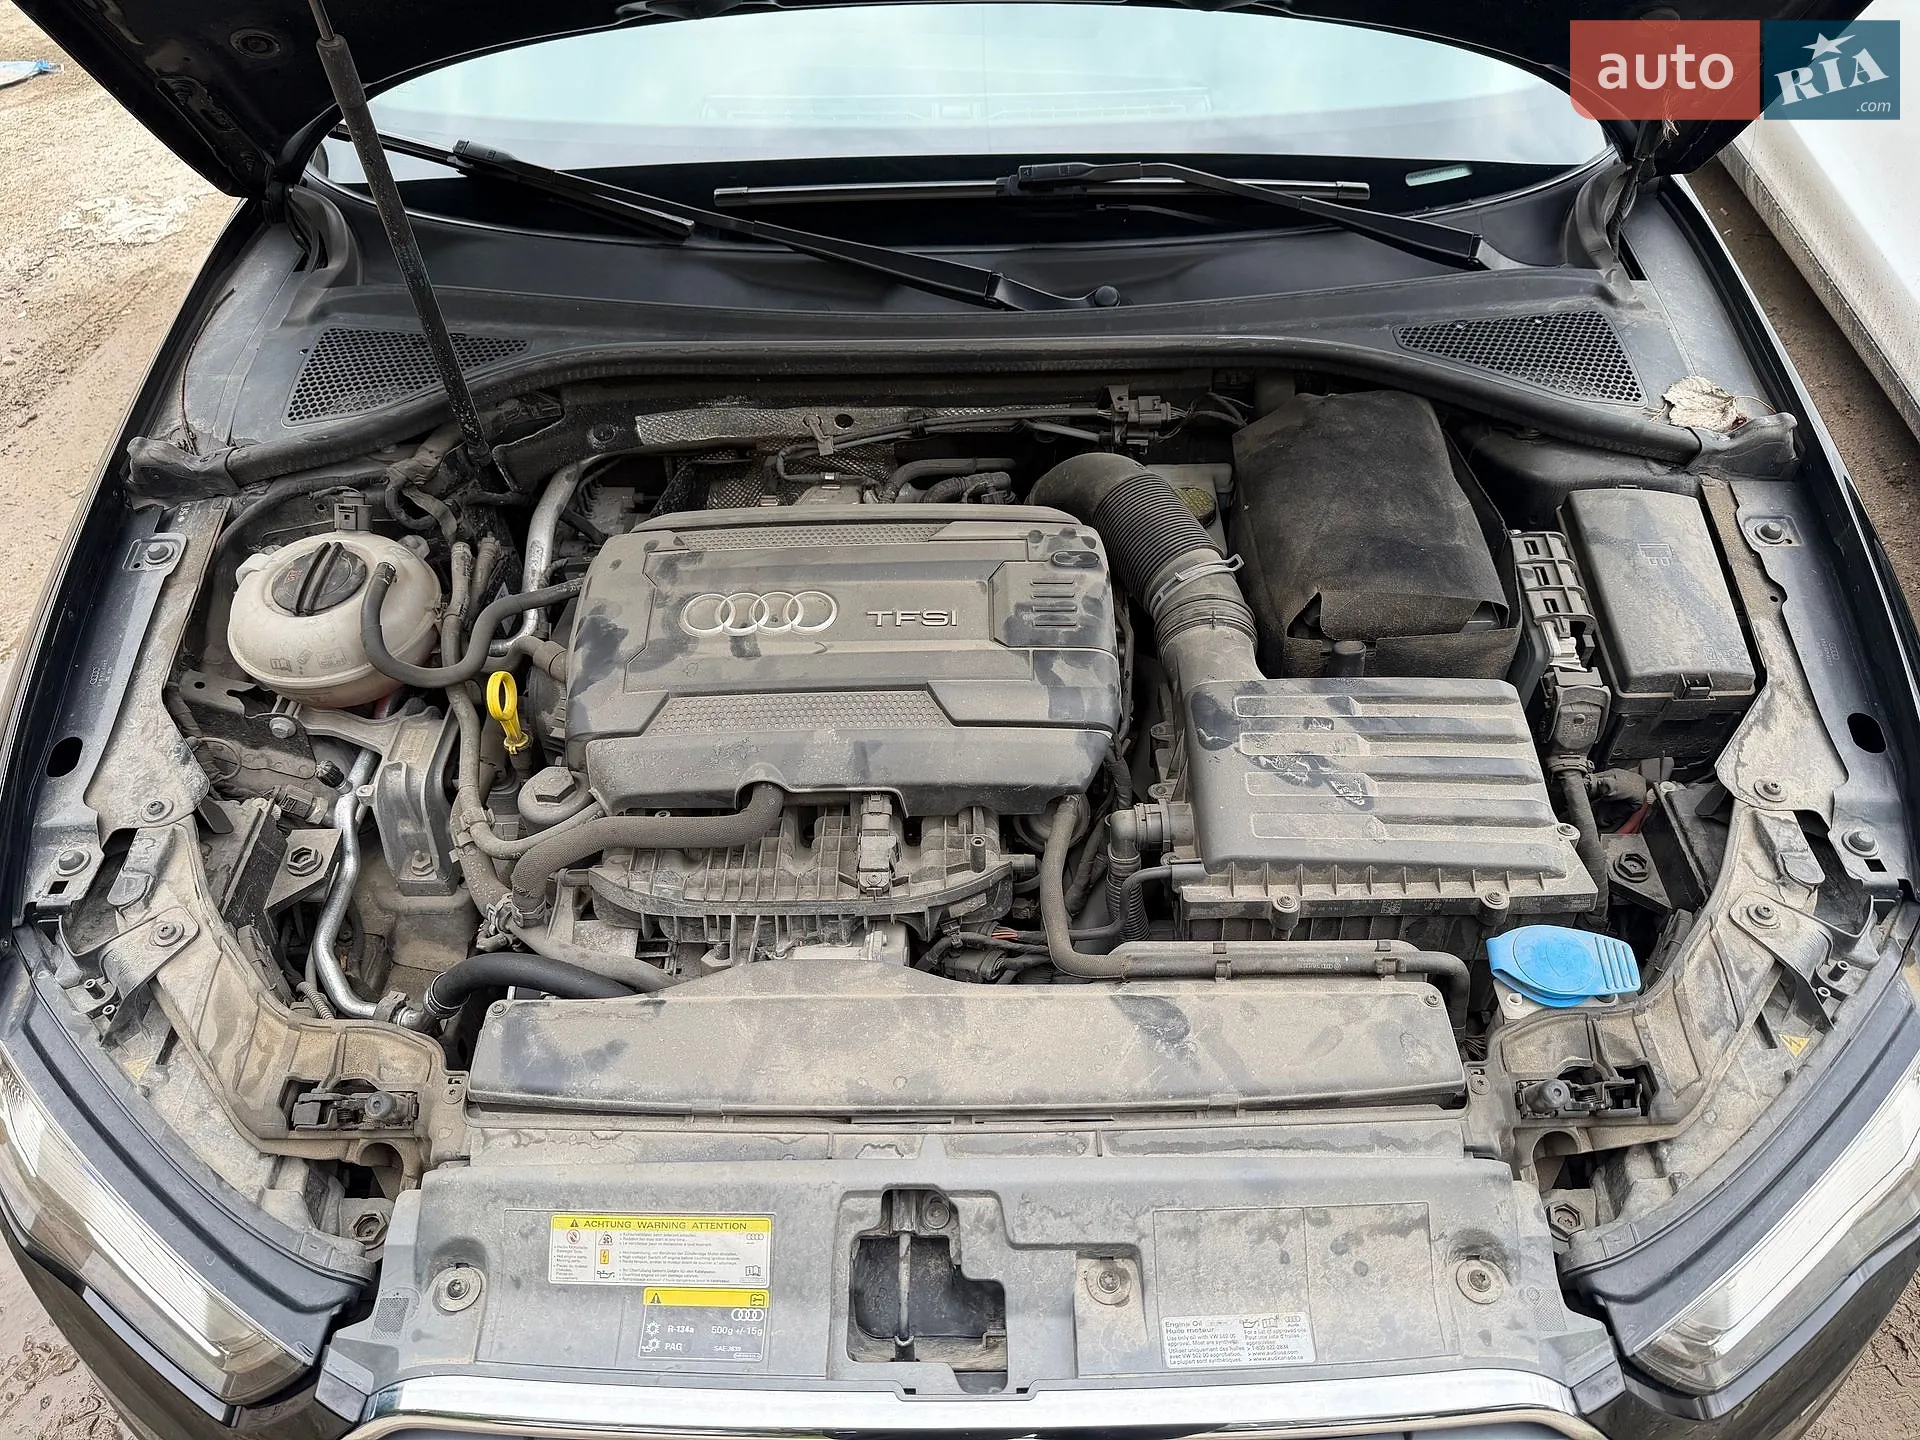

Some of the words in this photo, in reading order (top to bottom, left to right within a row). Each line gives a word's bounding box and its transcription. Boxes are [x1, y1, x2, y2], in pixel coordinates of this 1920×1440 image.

[866, 609, 959, 628] TFSI
[583, 1220, 632, 1229] ACHTUNG
[637, 1221, 687, 1230] WARNING
[692, 1221, 747, 1231] ATTENTION
[667, 1325, 695, 1334] R-134a
[711, 1325, 734, 1336] 500g
[664, 1343, 683, 1351] PAG
